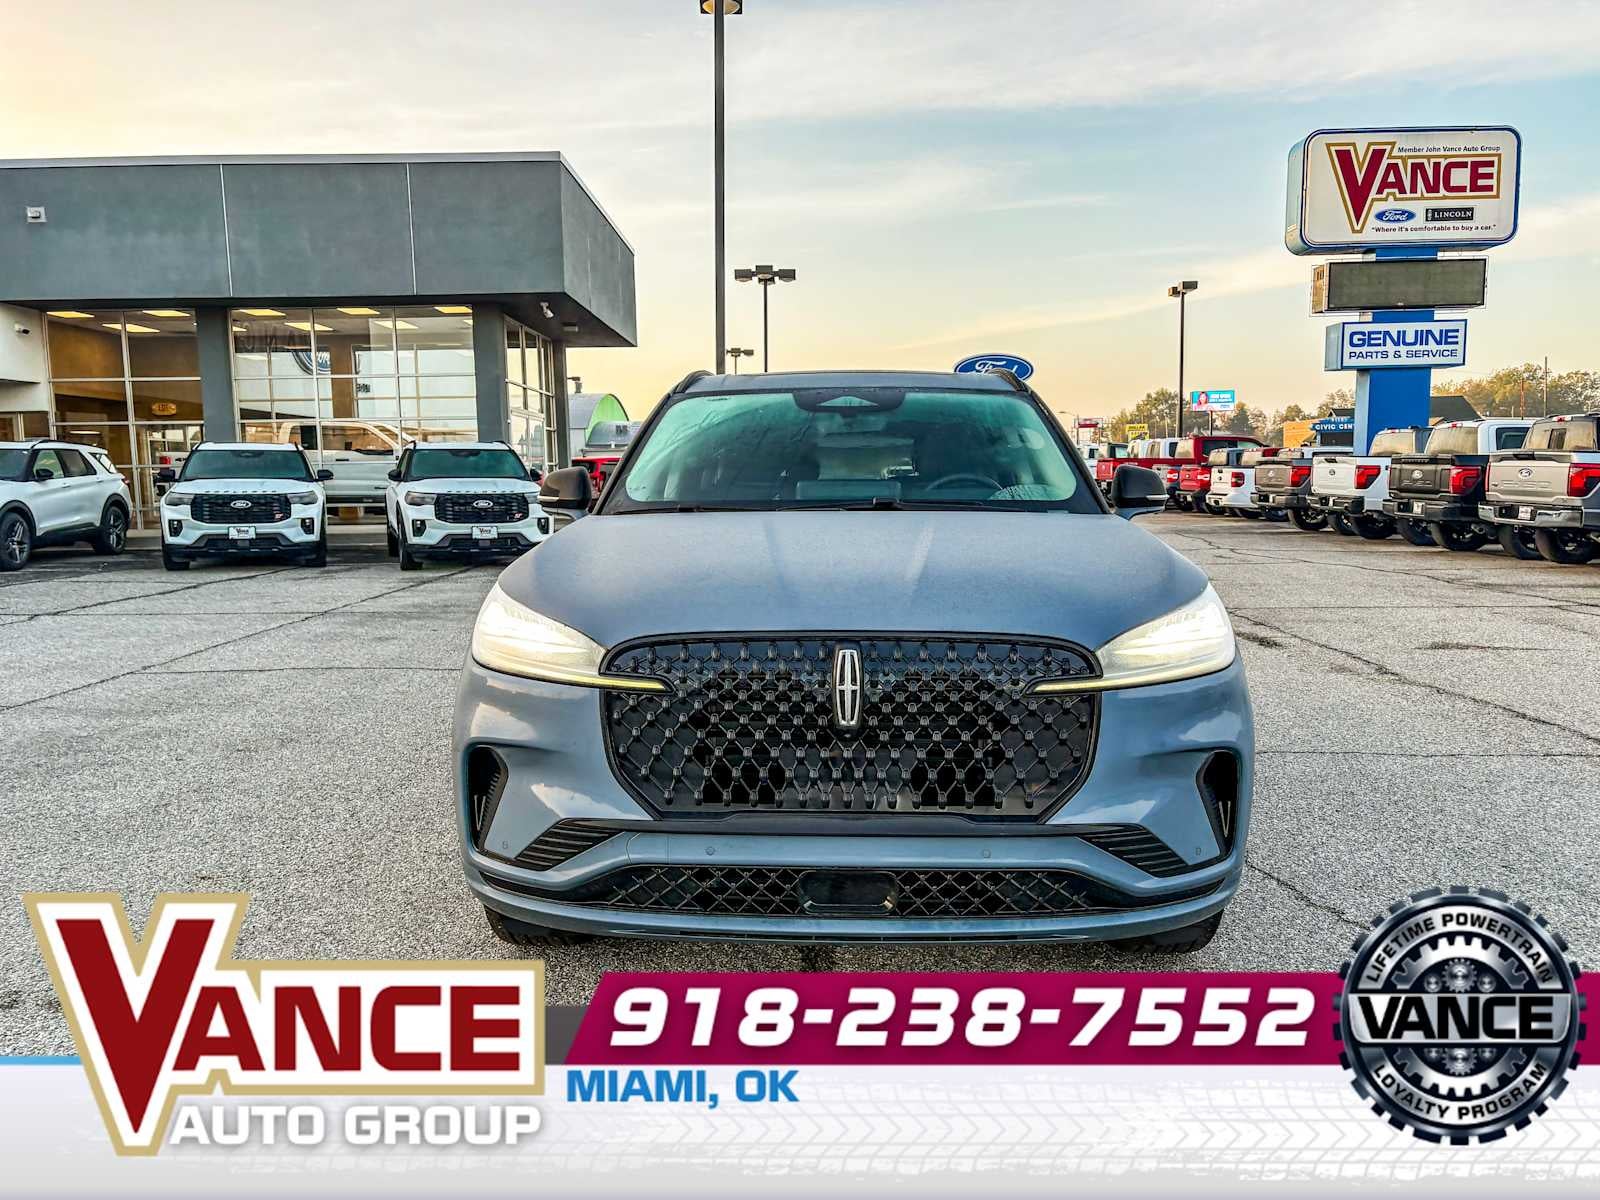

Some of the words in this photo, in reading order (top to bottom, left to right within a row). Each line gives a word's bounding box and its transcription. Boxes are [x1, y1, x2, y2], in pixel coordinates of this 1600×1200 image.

[1335, 149, 1494, 225] VANCE
[1382, 210, 1408, 221] Ford
[1434, 210, 1473, 218] LINCOLN
[1348, 328, 1460, 348] GENUINE
[1349, 350, 1389, 360] PARTS
[1393, 350, 1402, 359] &
[1405, 349, 1458, 359] SERVICE
